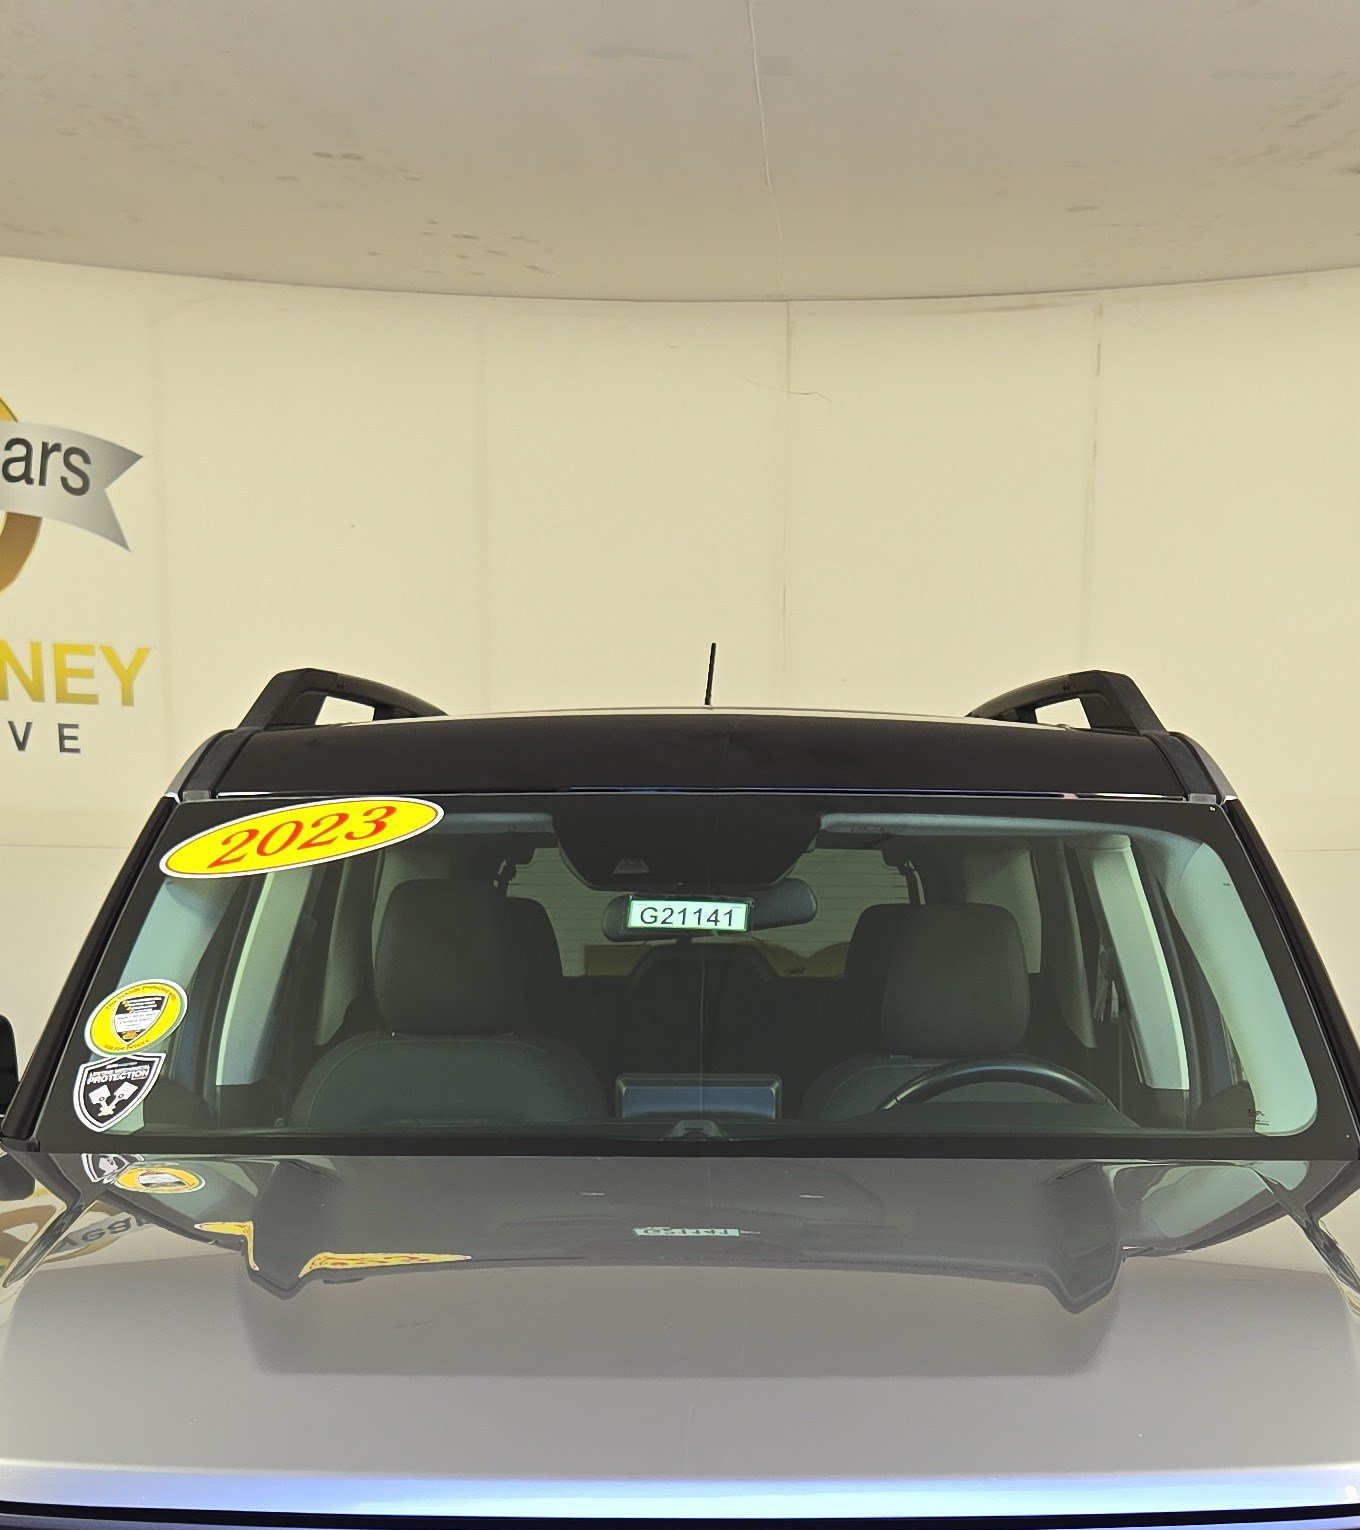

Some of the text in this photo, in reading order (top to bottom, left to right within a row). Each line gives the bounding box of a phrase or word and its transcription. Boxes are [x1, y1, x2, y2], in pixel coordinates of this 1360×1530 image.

[207, 805, 398, 870] 2023
[640, 905, 736, 928] G21141
[86, 1069, 150, 1085] PROTECTION
